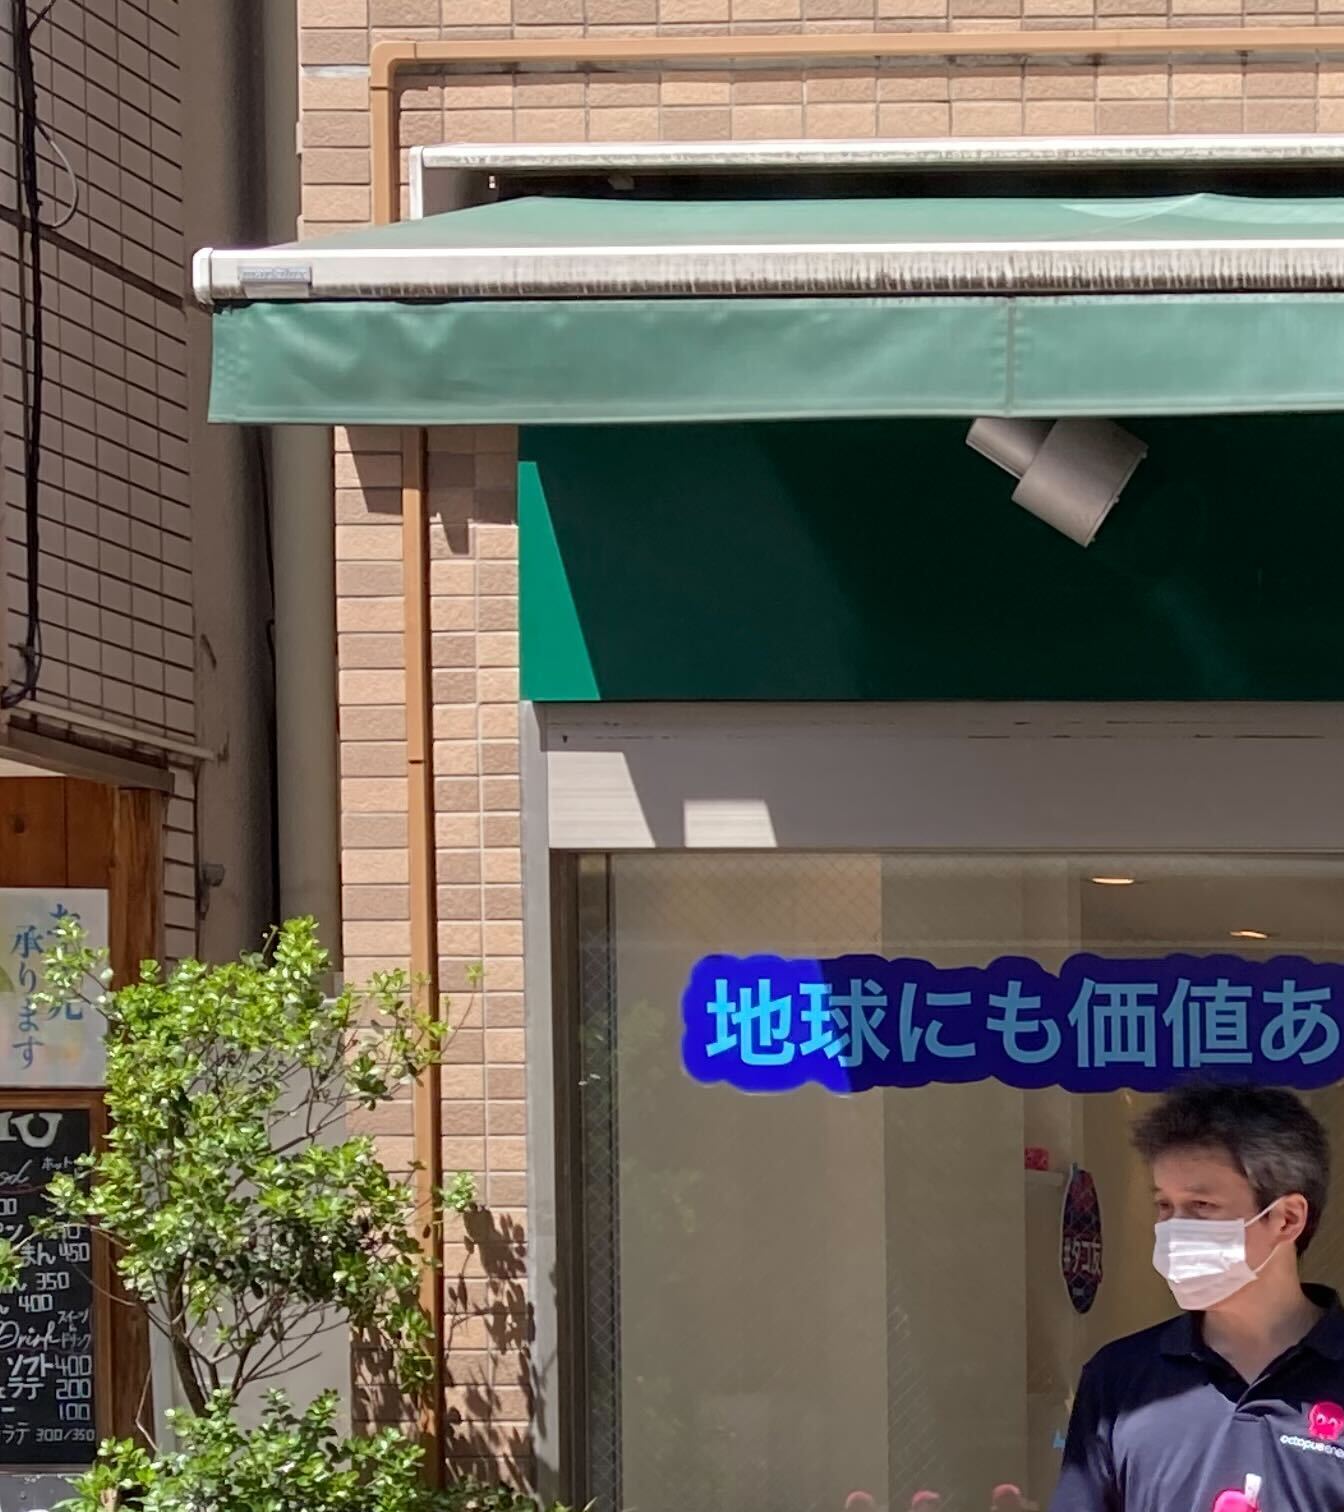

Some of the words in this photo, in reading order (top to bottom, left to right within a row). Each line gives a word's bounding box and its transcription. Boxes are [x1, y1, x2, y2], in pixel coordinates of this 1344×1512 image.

[59, 1242, 90, 1263] 450
[36, 1272, 70, 1291] 350
[19, 1294, 53, 1313] 400
[55, 1354, 92, 1377] 400
[56, 1379, 92, 1400] 200
[59, 1403, 91, 1421] 100
